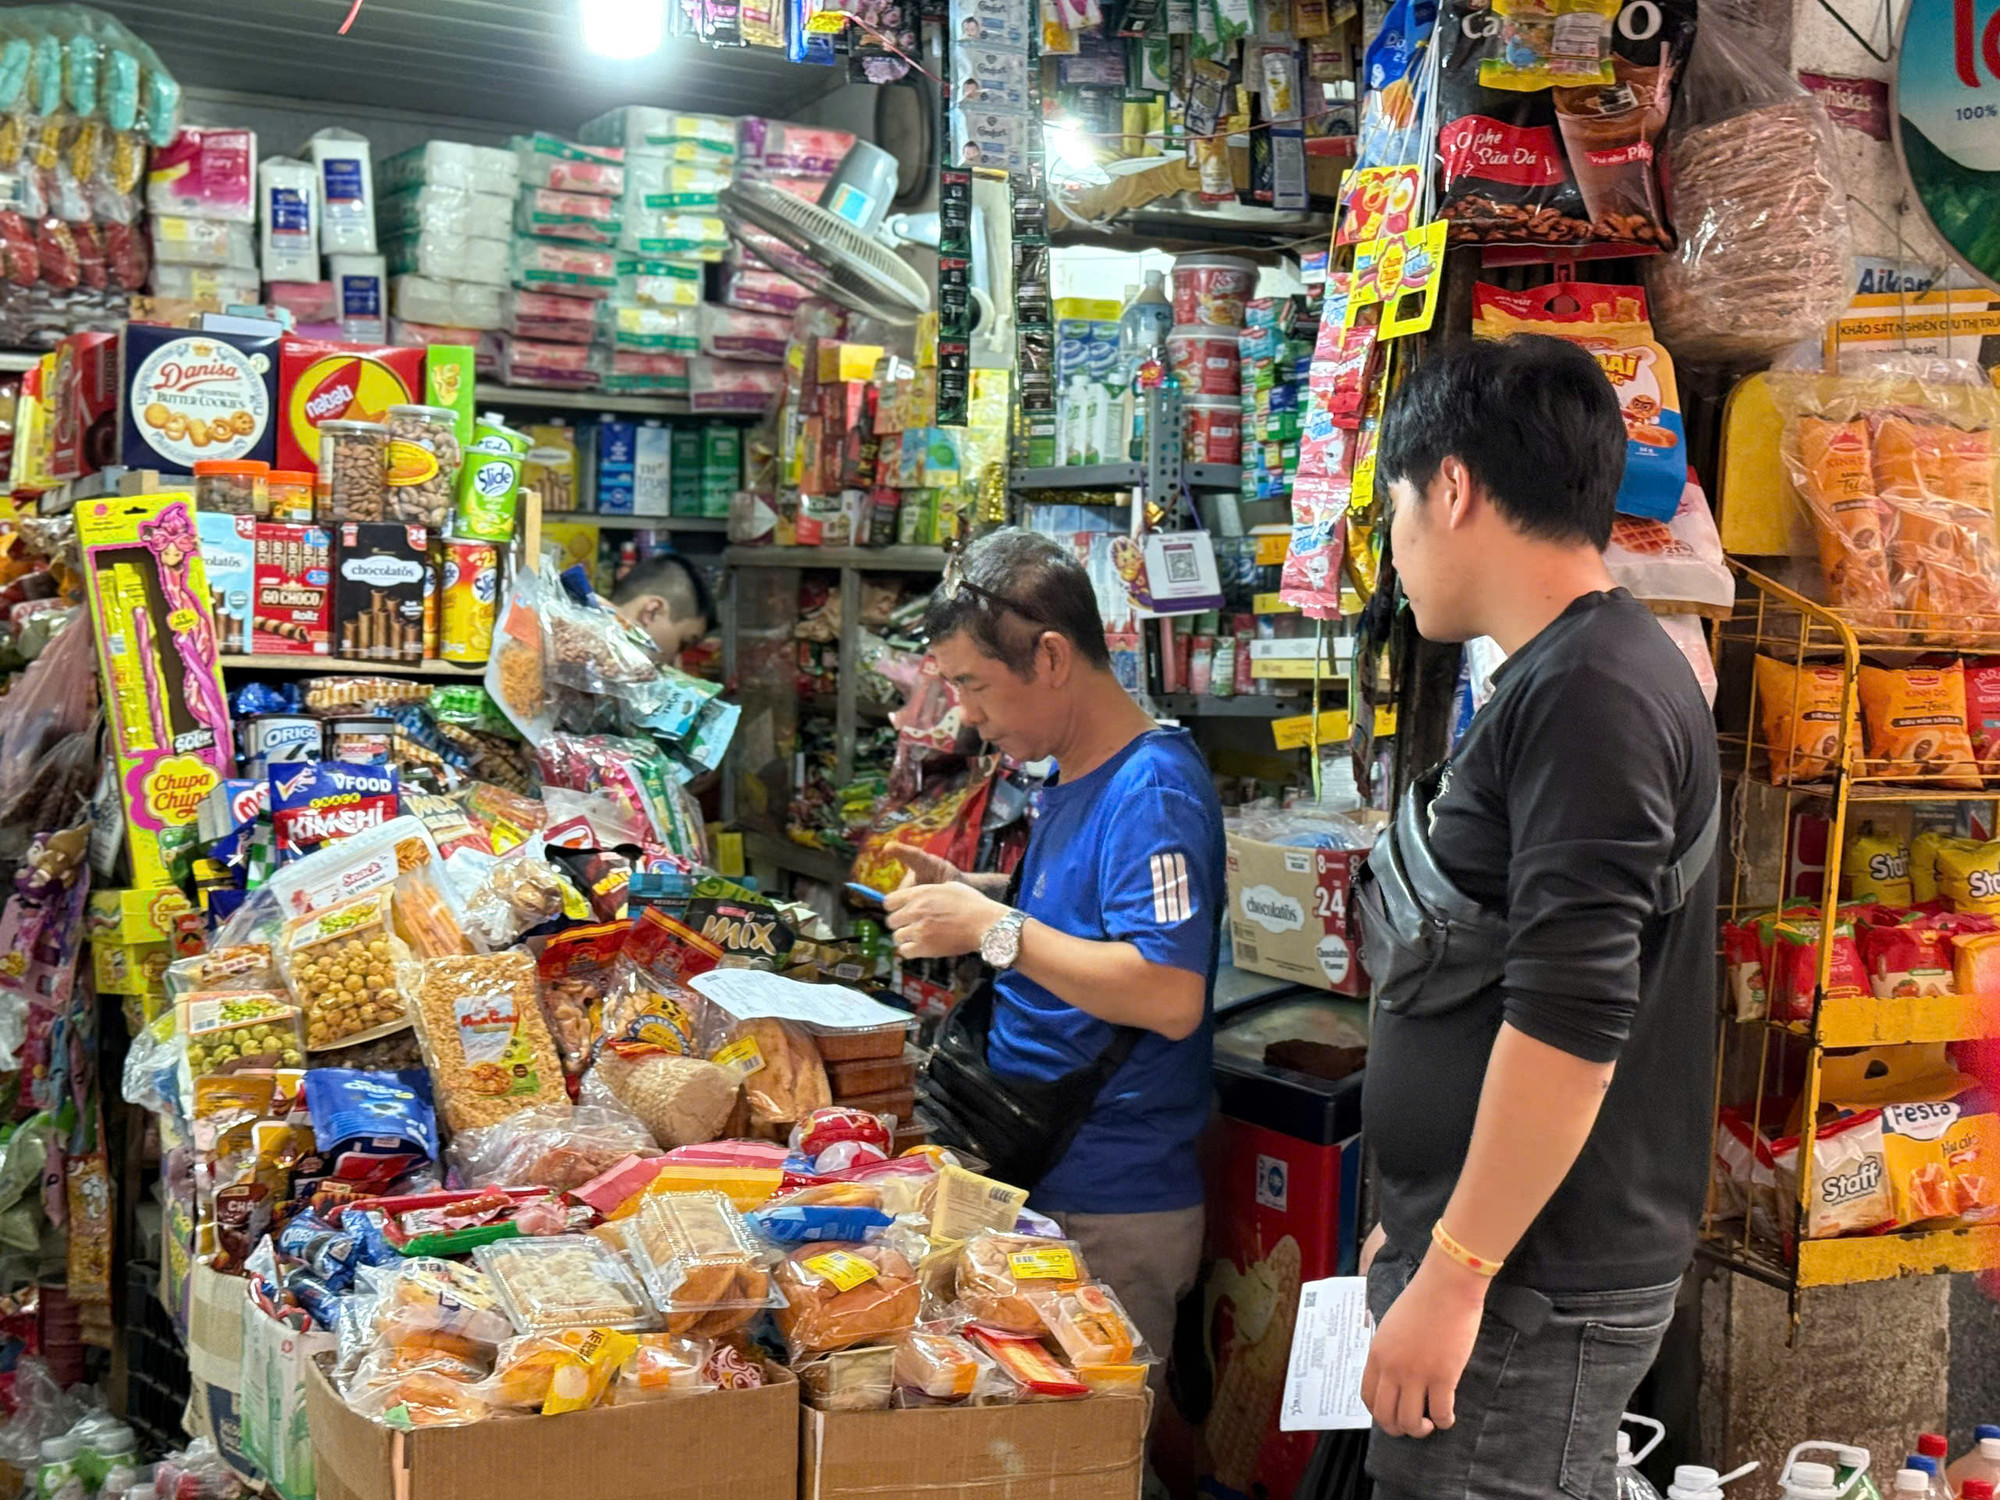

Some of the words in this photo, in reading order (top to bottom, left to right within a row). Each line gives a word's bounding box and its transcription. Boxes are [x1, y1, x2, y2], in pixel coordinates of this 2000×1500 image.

[1955, 103, 1998, 122] 100%
[152, 358, 242, 392] Danisa
[476, 468, 513, 493] Slide
[280, 590, 320, 606] CHOCO
[153, 772, 211, 794] Chupa
[342, 862, 382, 887] Snack
[1317, 854, 1327, 875] 8
[1315, 885, 1346, 919] 24
[1822, 1156, 1882, 1203] Staff
